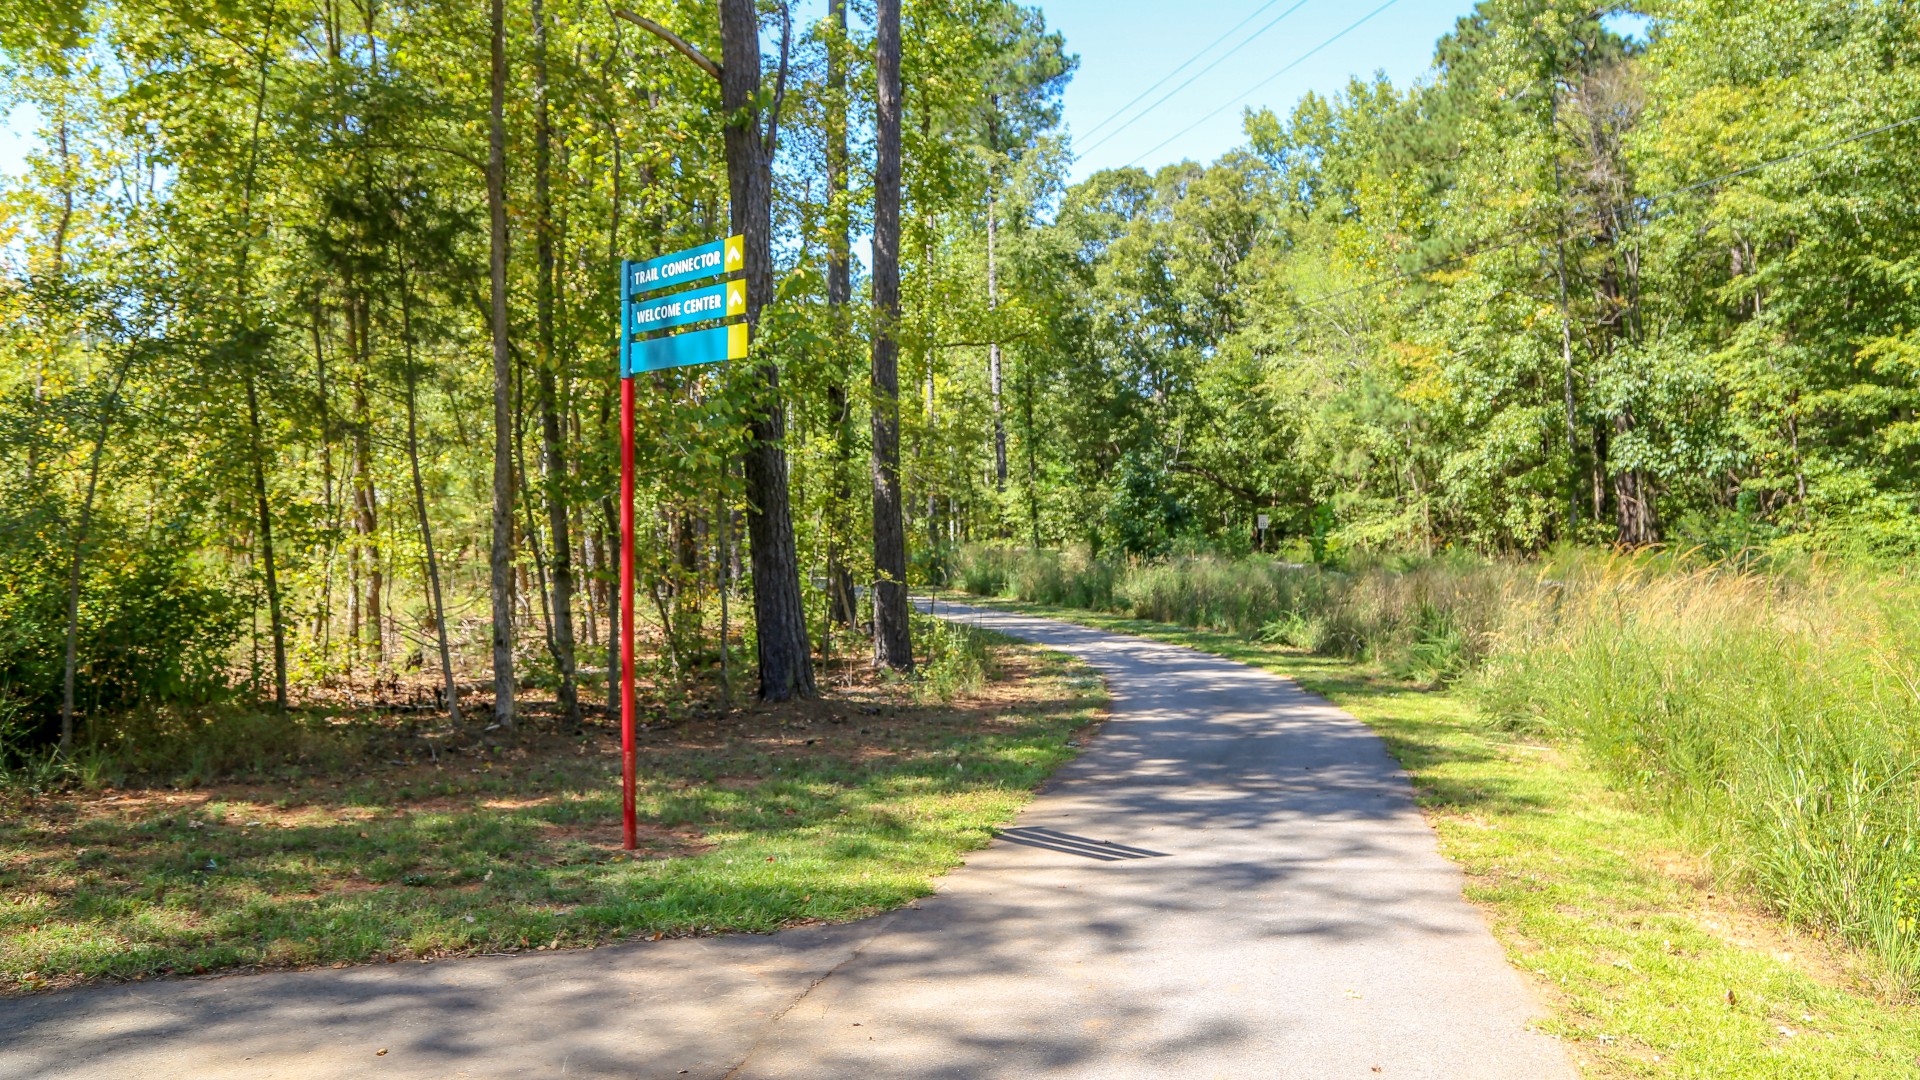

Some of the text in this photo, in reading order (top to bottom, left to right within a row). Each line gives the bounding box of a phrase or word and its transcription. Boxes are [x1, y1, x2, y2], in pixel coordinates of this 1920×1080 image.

[635, 251, 721, 285] TRAIL CONNECTOR
[637, 294, 722, 323] WELCOME CENTER
